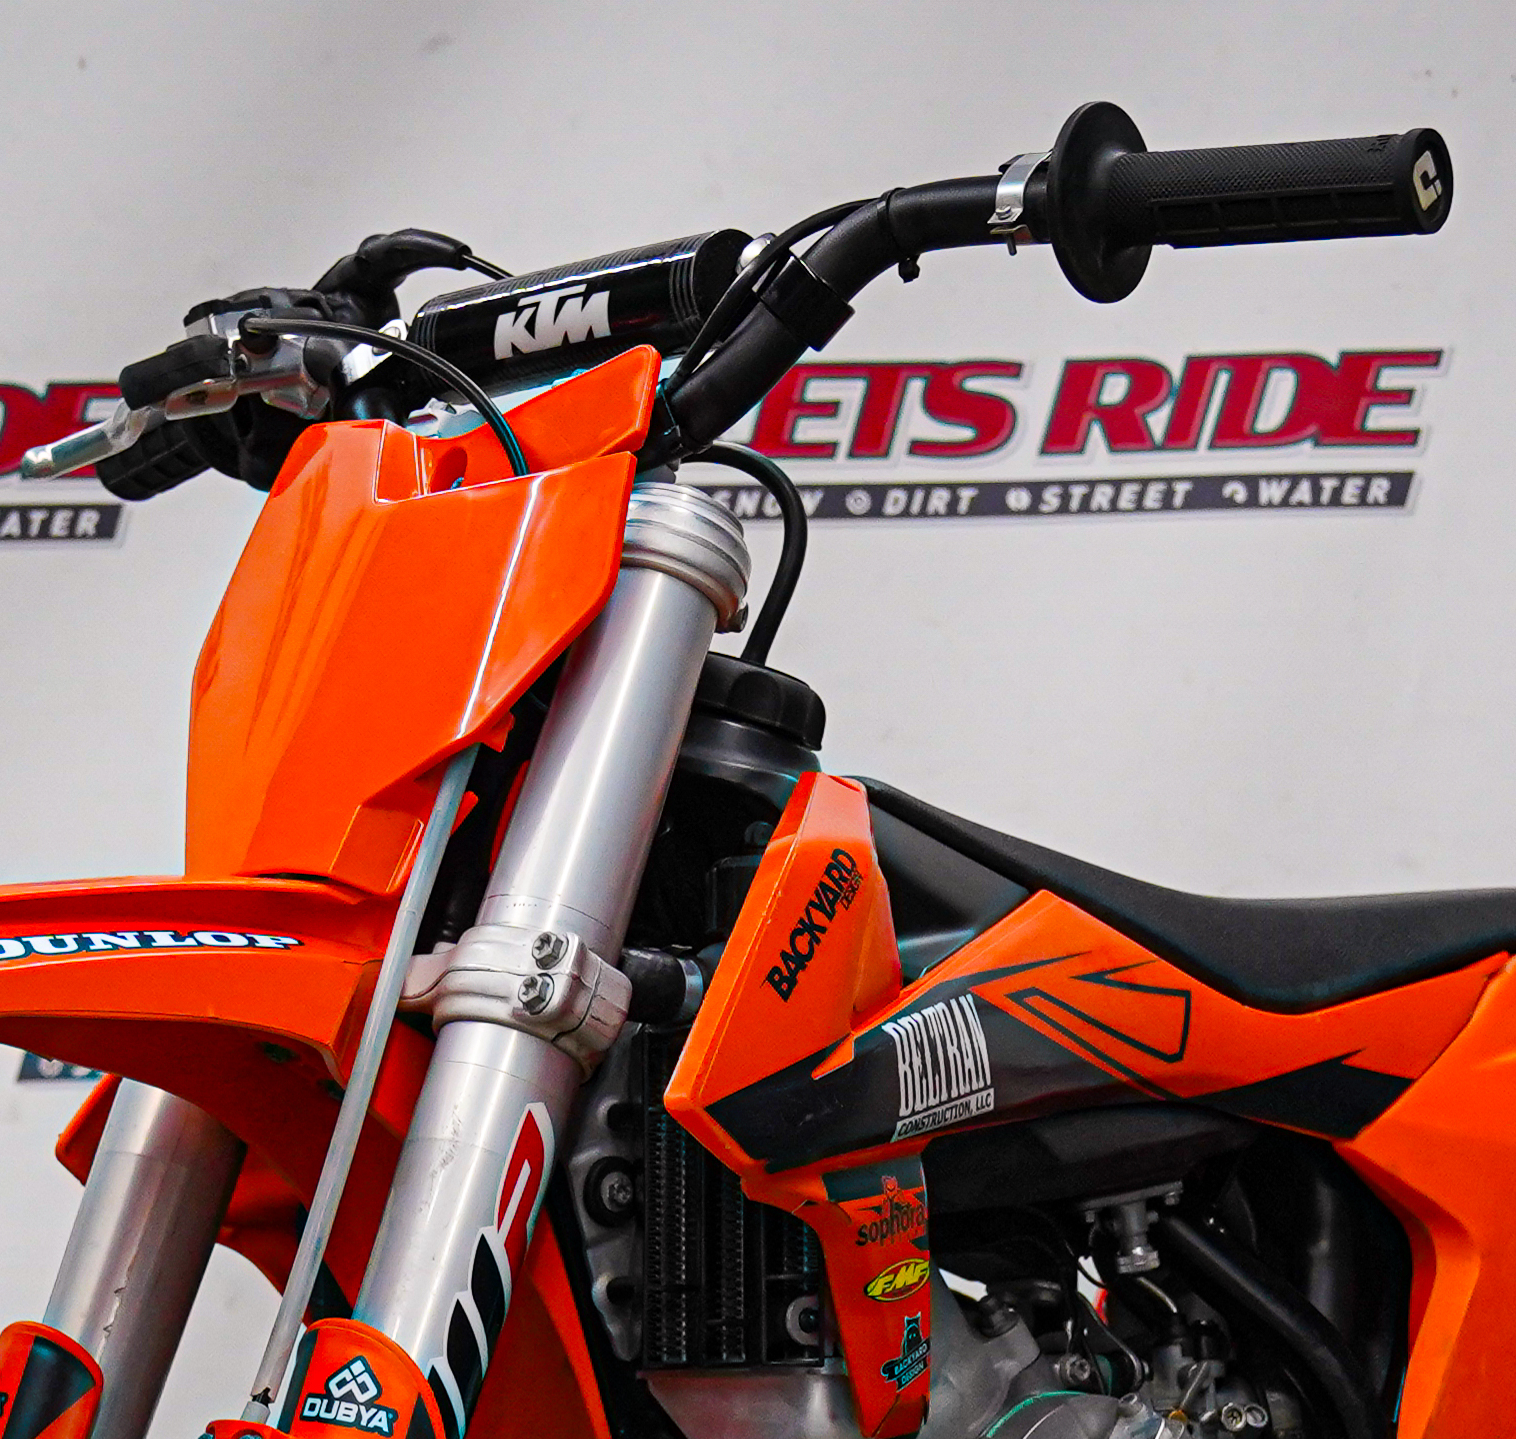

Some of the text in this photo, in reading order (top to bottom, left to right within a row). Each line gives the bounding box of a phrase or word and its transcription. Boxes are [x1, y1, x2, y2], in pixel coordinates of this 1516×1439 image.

[494, 284, 611, 360] KTM
[748, 350, 1444, 459] ETS RIDE
[882, 487, 977, 516] DIRT
[1039, 481, 1193, 511] STREET
[1258, 478, 1391, 506] WATER
[765, 848, 857, 1002] BACKYARD
[882, 994, 991, 1117] BELTRAN
[898, 1093, 991, 1136] CONSTRUCTION, LLC
[868, 1261, 929, 1296] FMF
[302, 1397, 392, 1433] DUBYA
